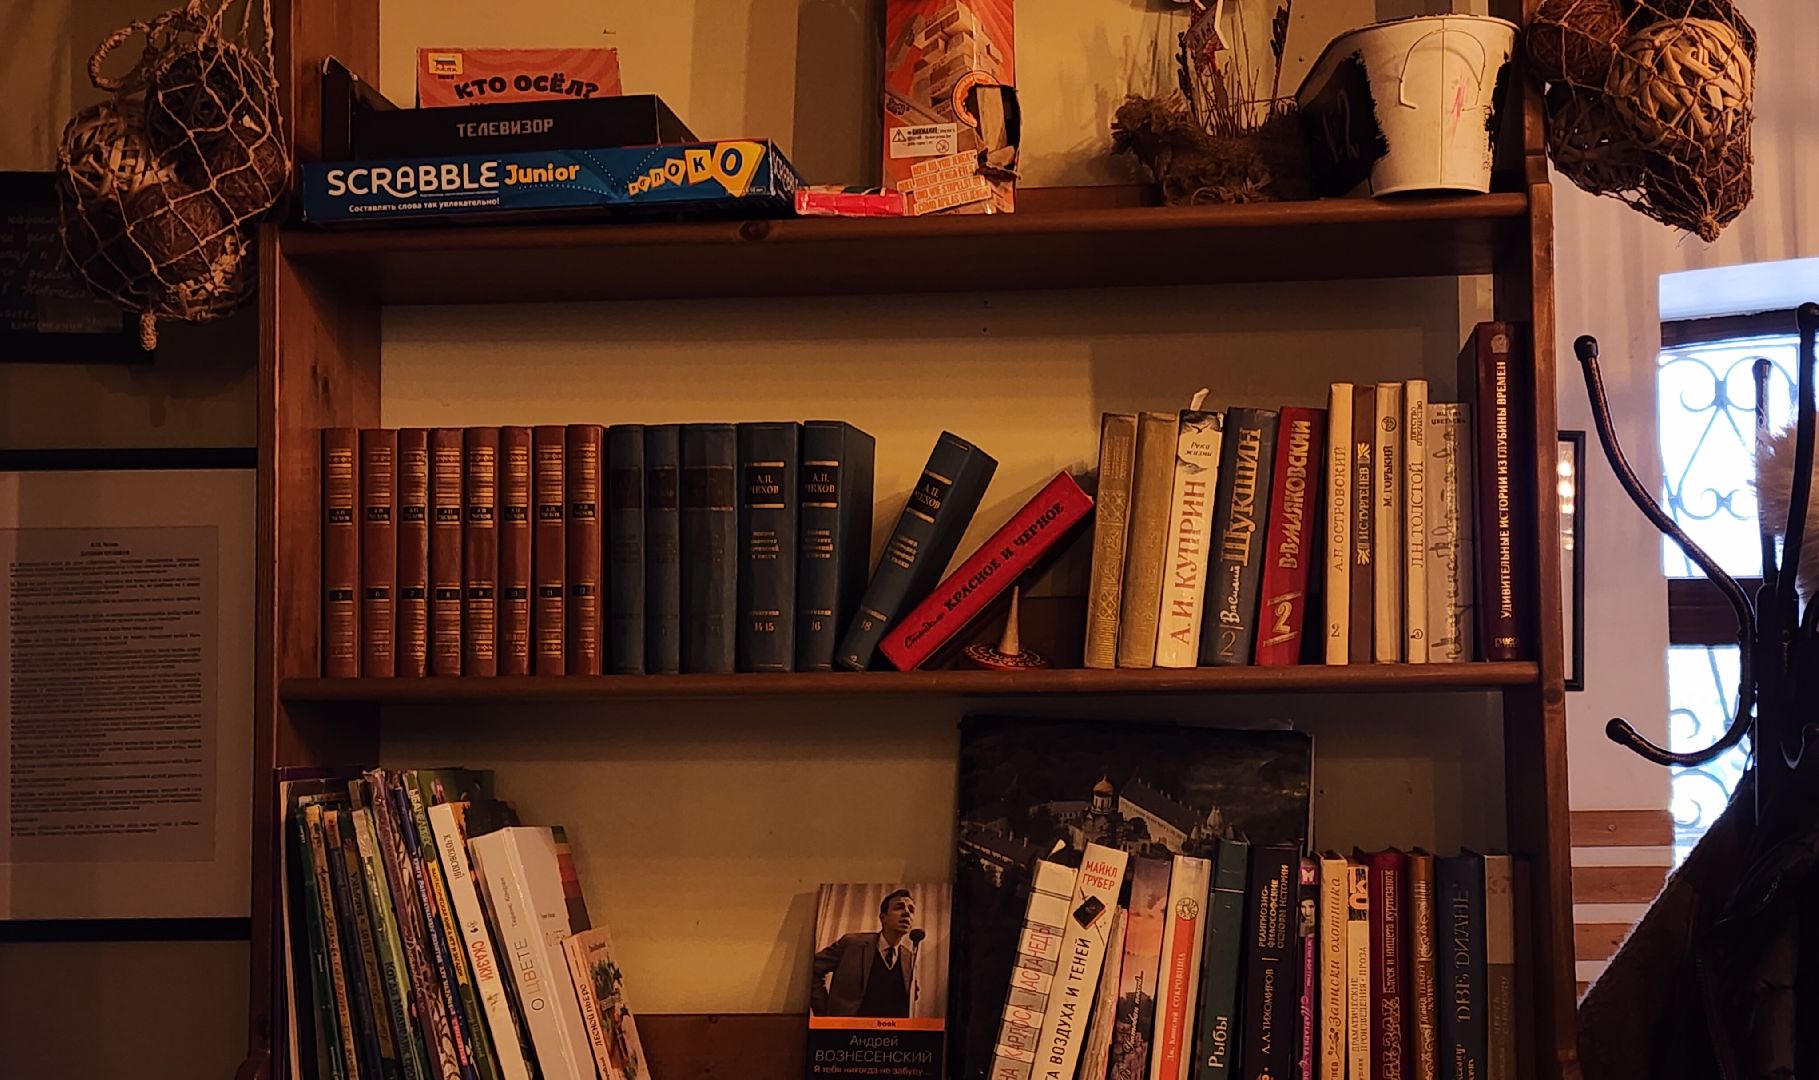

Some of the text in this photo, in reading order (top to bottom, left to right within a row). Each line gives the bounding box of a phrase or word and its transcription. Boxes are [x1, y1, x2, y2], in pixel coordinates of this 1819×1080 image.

[454, 73, 600, 100] КТО ОСЁЛ?
[455, 117, 555, 139] ТЕЛЕВИЗОР
[325, 160, 581, 200] SCRABBLE Junior
[348, 197, 500, 214] Составлять слова так увлекательно!
[1495, 360, 1508, 408] ВРЕМЕН
[1497, 408, 1509, 460] ГЛУБИНЫ
[1383, 445, 1393, 494] ГОРЬКИЙ
[1497, 460, 1509, 475] ИЗ
[1333, 445, 1346, 544] ОСТРОВСКИЙ
[1408, 461, 1424, 568] Л.Н. ТОЛСТОЙ
[1497, 474, 1511, 529] ИСТОРИИ
[943, 557, 1002, 612] КРАСНОЕ
[1000, 545, 1015, 561] И
[1013, 501, 1065, 548] ЧЕРНОЕ
[1171, 479, 1207, 646] А.И. КУПРИН
[1500, 528, 1513, 621] УДИВИТЕЛЬНЫЕ
[1219, 563, 1241, 625] Василий
[1273, 600, 1294, 633] 2
[1218, 631, 1236, 657] 2
[1331, 623, 1340, 638] 2
[1082, 873, 1116, 891] ГРУБЕР
[1085, 859, 1119, 878] МАЙКЛ
[1258, 883, 1269, 949] РЕЛИГИОЗНО-
[1268, 878, 1280, 949] ФИЛОСОФСКИЕ
[1277, 863, 1290, 950] ОСНОВЫ ИСТОРИИ
[1331, 877, 1342, 954] охотника
[1384, 868, 1396, 922] куртизанок
[470, 940, 495, 982] СКАЗКИ
[1018, 925, 1052, 998] КАСТАНЕДЫ
[1069, 937, 1092, 984] ТЕНЕЙ
[1359, 946, 1368, 980] ПРОЗА
[1384, 923, 1396, 957] нищета
[513, 940, 545, 1012] О ЦВЕТЕ
[1065, 986, 1080, 998] И
[1171, 952, 1186, 1009] СОКРОВИЩА
[1261, 968, 1276, 1029] ТИХОМИРОВ
[1327, 959, 1342, 1028] Записки
[1384, 966, 1396, 994] Блеск
[1455, 972, 1472, 1023] ДВЕ
[585, 1008, 604, 1047] ЛЕСНОЙ
[876, 1019, 897, 1028] book
[1005, 1003, 1033, 1061] КАРЛОСА
[1049, 1002, 1077, 1066] ВОЗДУХА
[1351, 977, 1360, 1053] ДРАМАТИЧЕСКИЕ
[1359, 984, 1368, 1053] ПРОИЗВЕДЕНИЯ
[814, 1049, 934, 1065] ВОЗНЕСЕНСКИЙ
[849, 1034, 900, 1049] Андрей
[1207, 1015, 1229, 1069] Рыбы
[813, 1065, 821, 1073] Я
[843, 1066, 878, 1075] никогда
